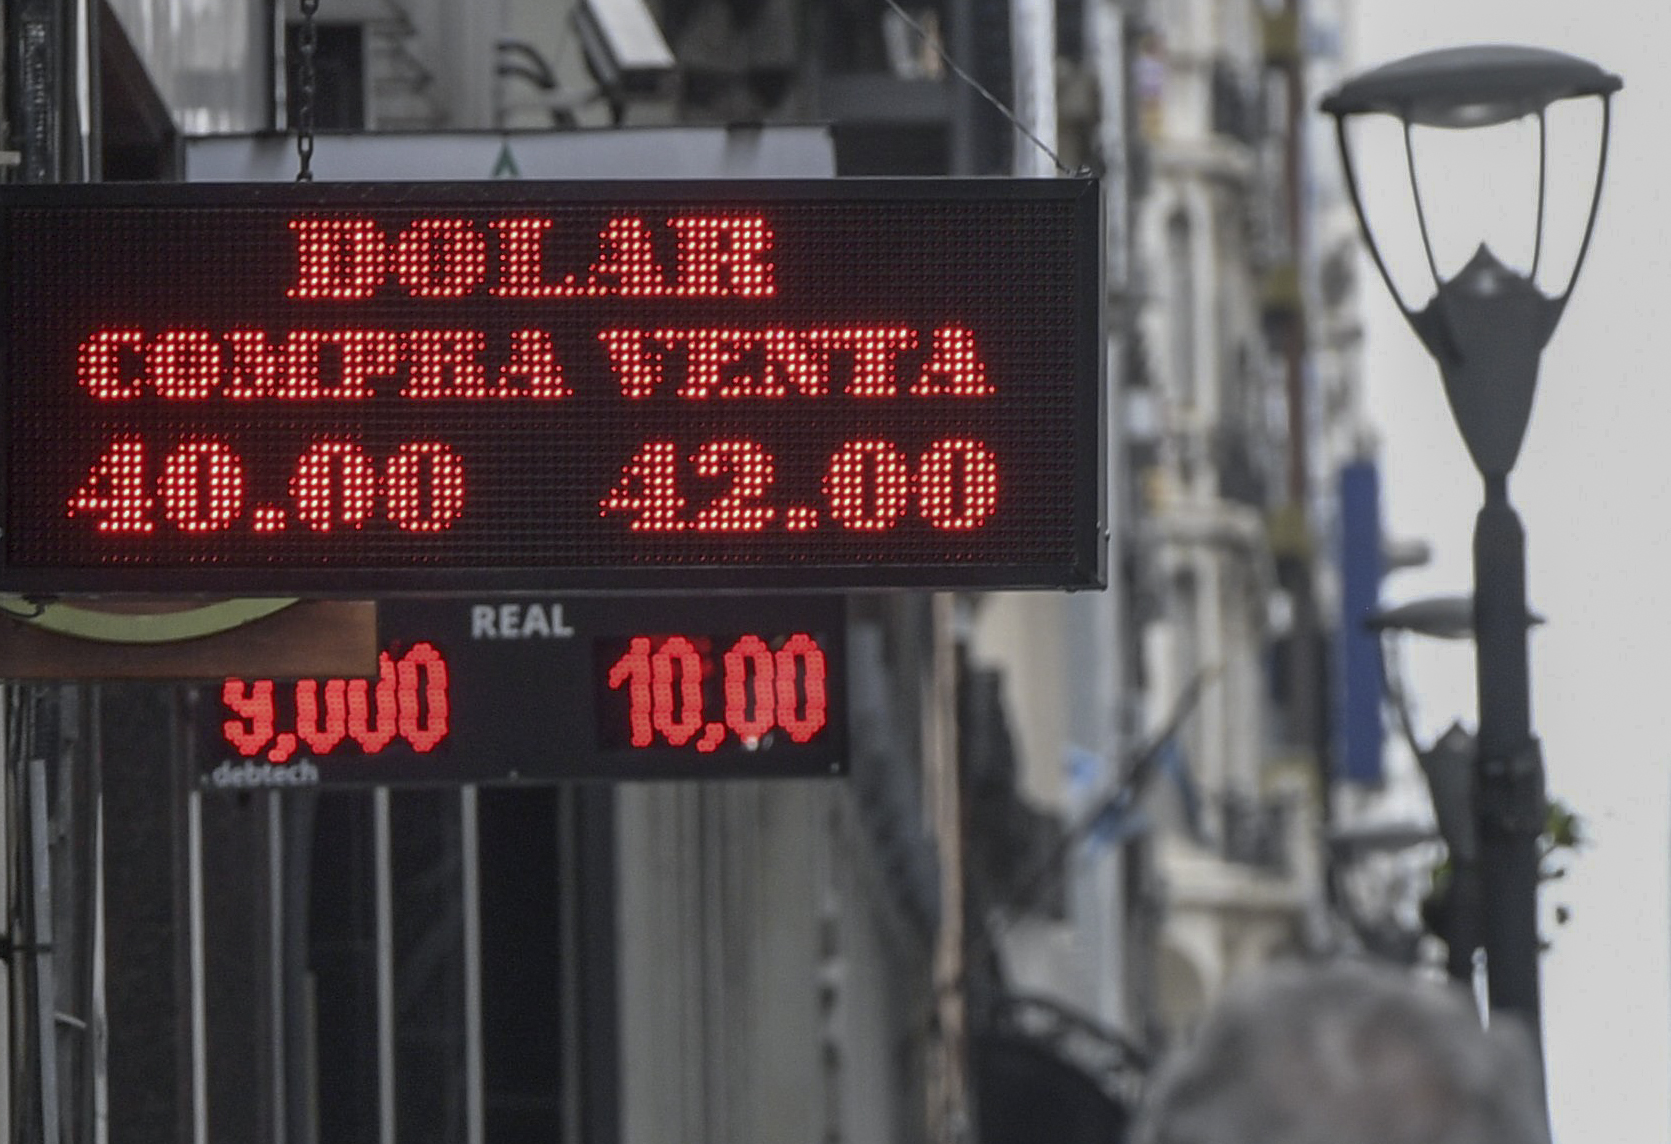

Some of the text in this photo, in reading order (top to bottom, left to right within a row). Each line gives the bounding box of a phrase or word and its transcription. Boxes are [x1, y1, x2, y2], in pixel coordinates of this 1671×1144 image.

[285, 215, 777, 300] DOLAR
[76, 326, 997, 401] COMPRA VENTA
[67, 438, 998, 533] 40.00 42.00
[471, 604, 575, 639] REAL
[609, 633, 827, 752] 10,00
